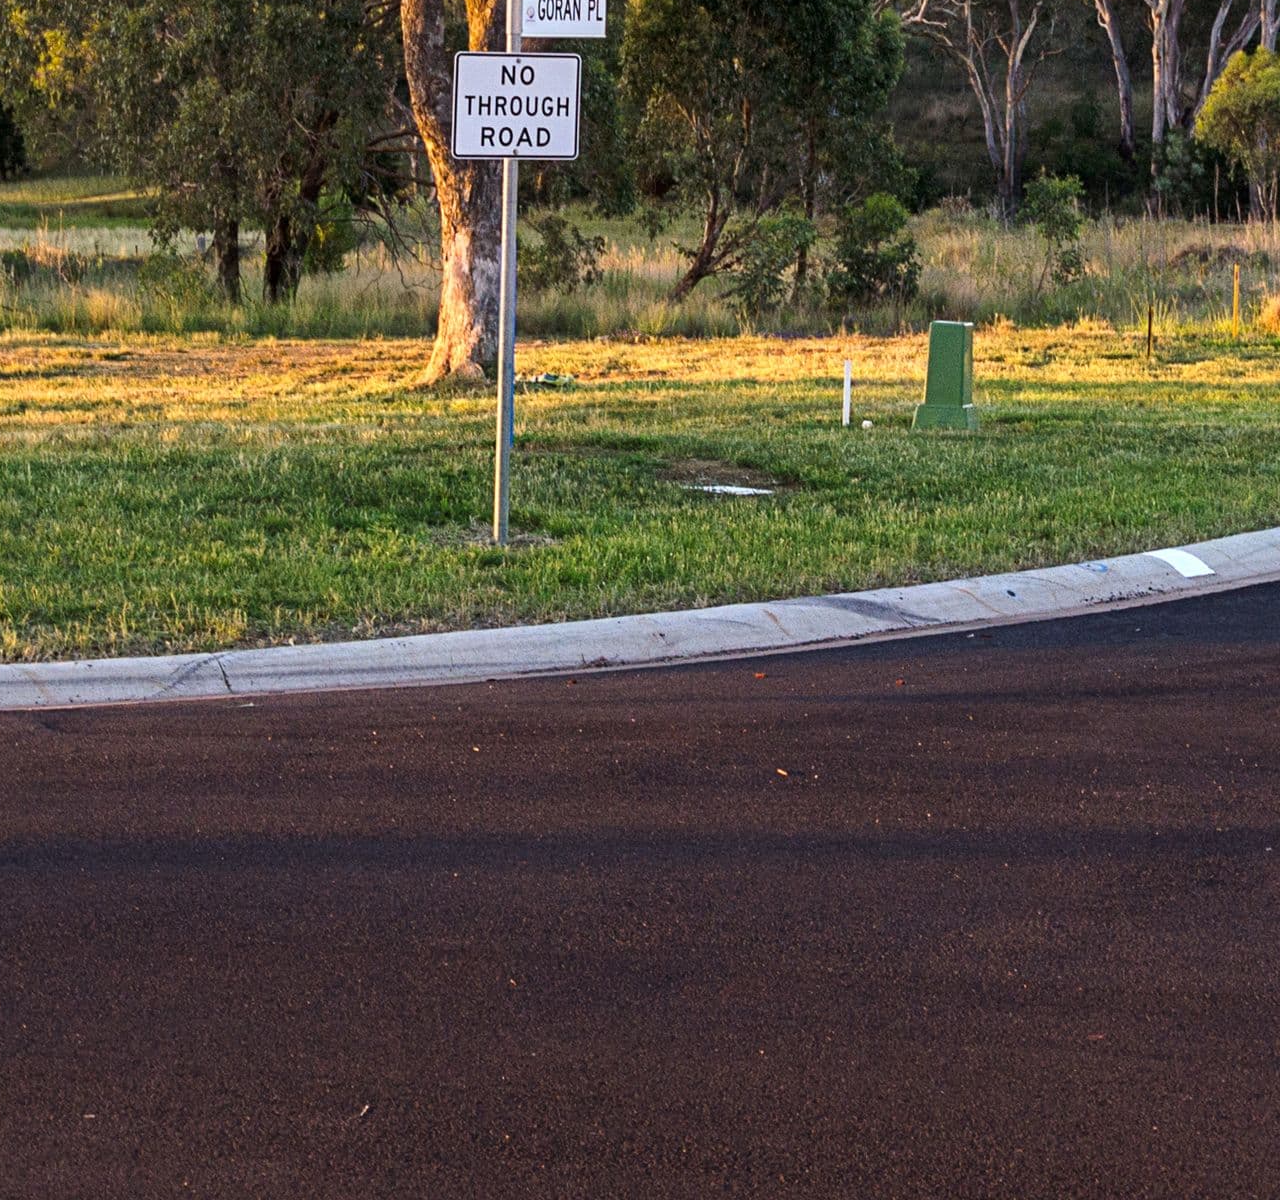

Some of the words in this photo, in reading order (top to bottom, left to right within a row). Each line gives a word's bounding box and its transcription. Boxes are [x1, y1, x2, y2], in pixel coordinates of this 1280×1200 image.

[500, 65, 535, 86] NO
[464, 95, 570, 118] THROUGH
[480, 127, 551, 148] ROAD
